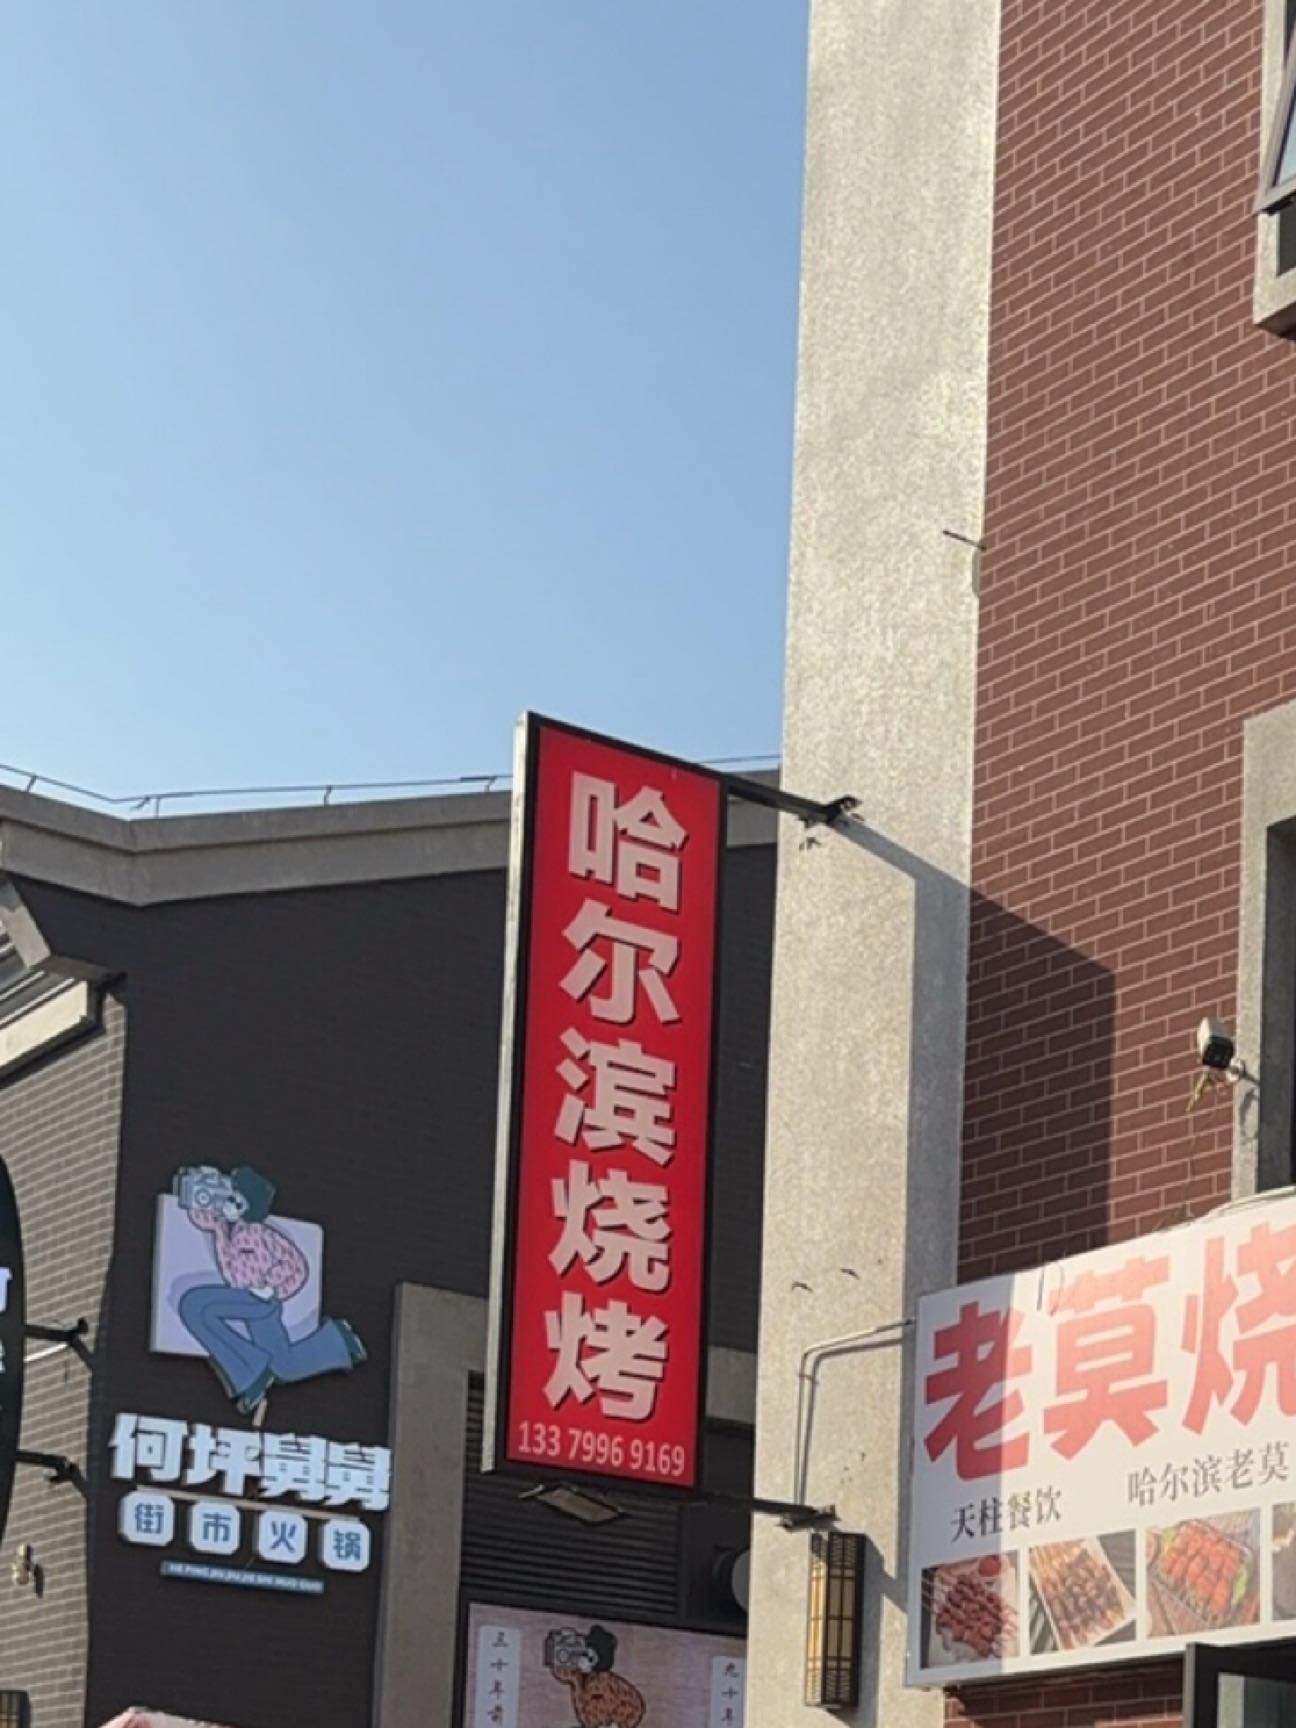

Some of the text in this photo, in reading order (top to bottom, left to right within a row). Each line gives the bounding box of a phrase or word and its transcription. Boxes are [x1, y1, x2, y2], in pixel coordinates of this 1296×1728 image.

[543, 769, 687, 1422] 哈尔滨烧烤
[518, 1420, 685, 1477] 133 7996 9169
[1128, 1441, 1290, 1507] 哈尔滨老莫
[134, 1502, 362, 1562] 街市火锅
[951, 1485, 1062, 1543] 天柱餐饮
